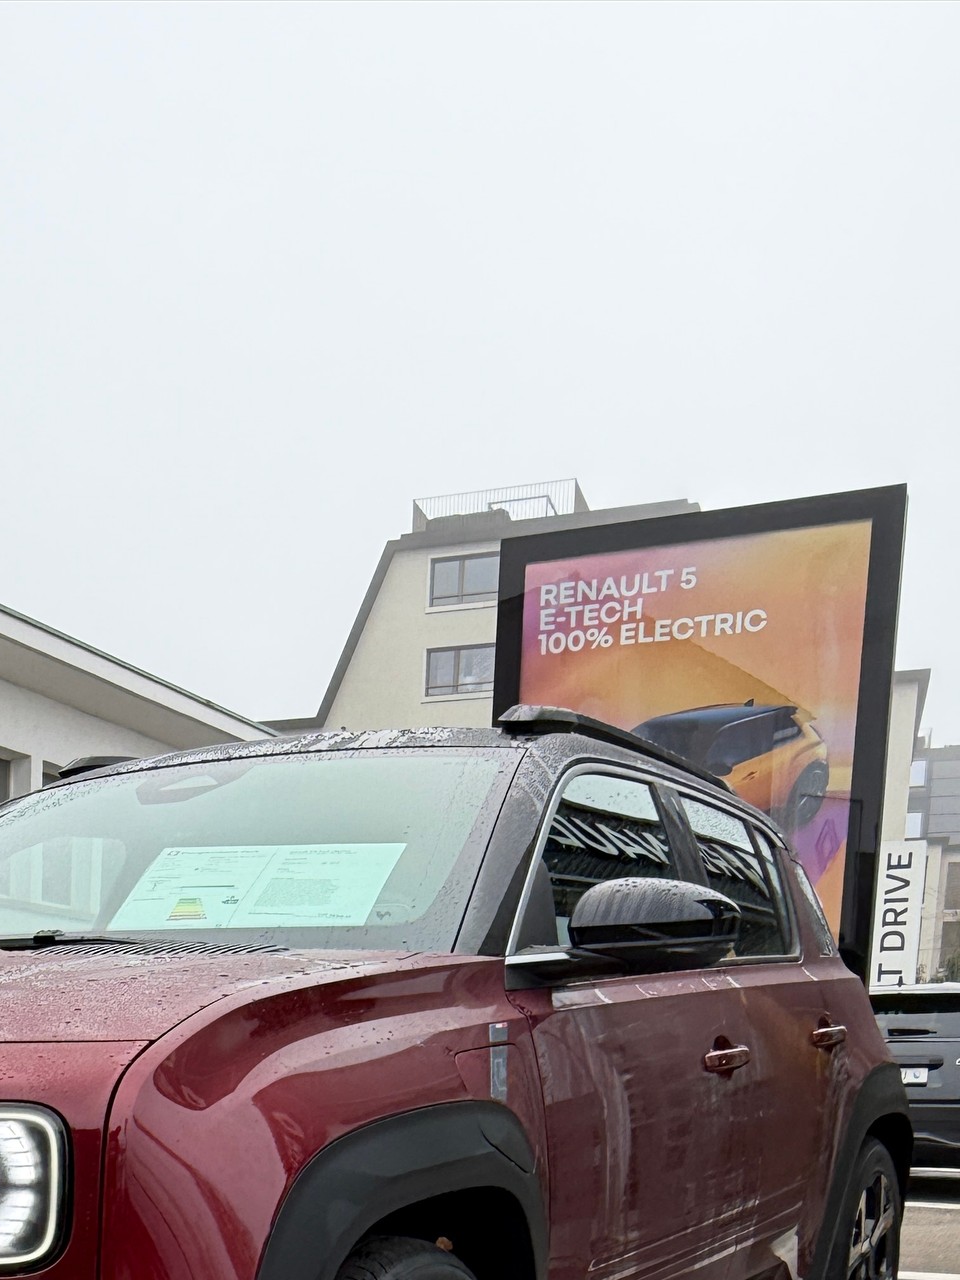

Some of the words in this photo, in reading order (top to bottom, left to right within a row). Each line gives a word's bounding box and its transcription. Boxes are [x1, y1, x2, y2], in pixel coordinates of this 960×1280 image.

[540, 569, 674, 606] RENAULT
[680, 567, 697, 590] 5
[538, 627, 613, 656] 100%
[620, 609, 768, 645] ELECTRIC
[540, 598, 643, 631] E-TECH
[880, 851, 913, 953] DRIVE
